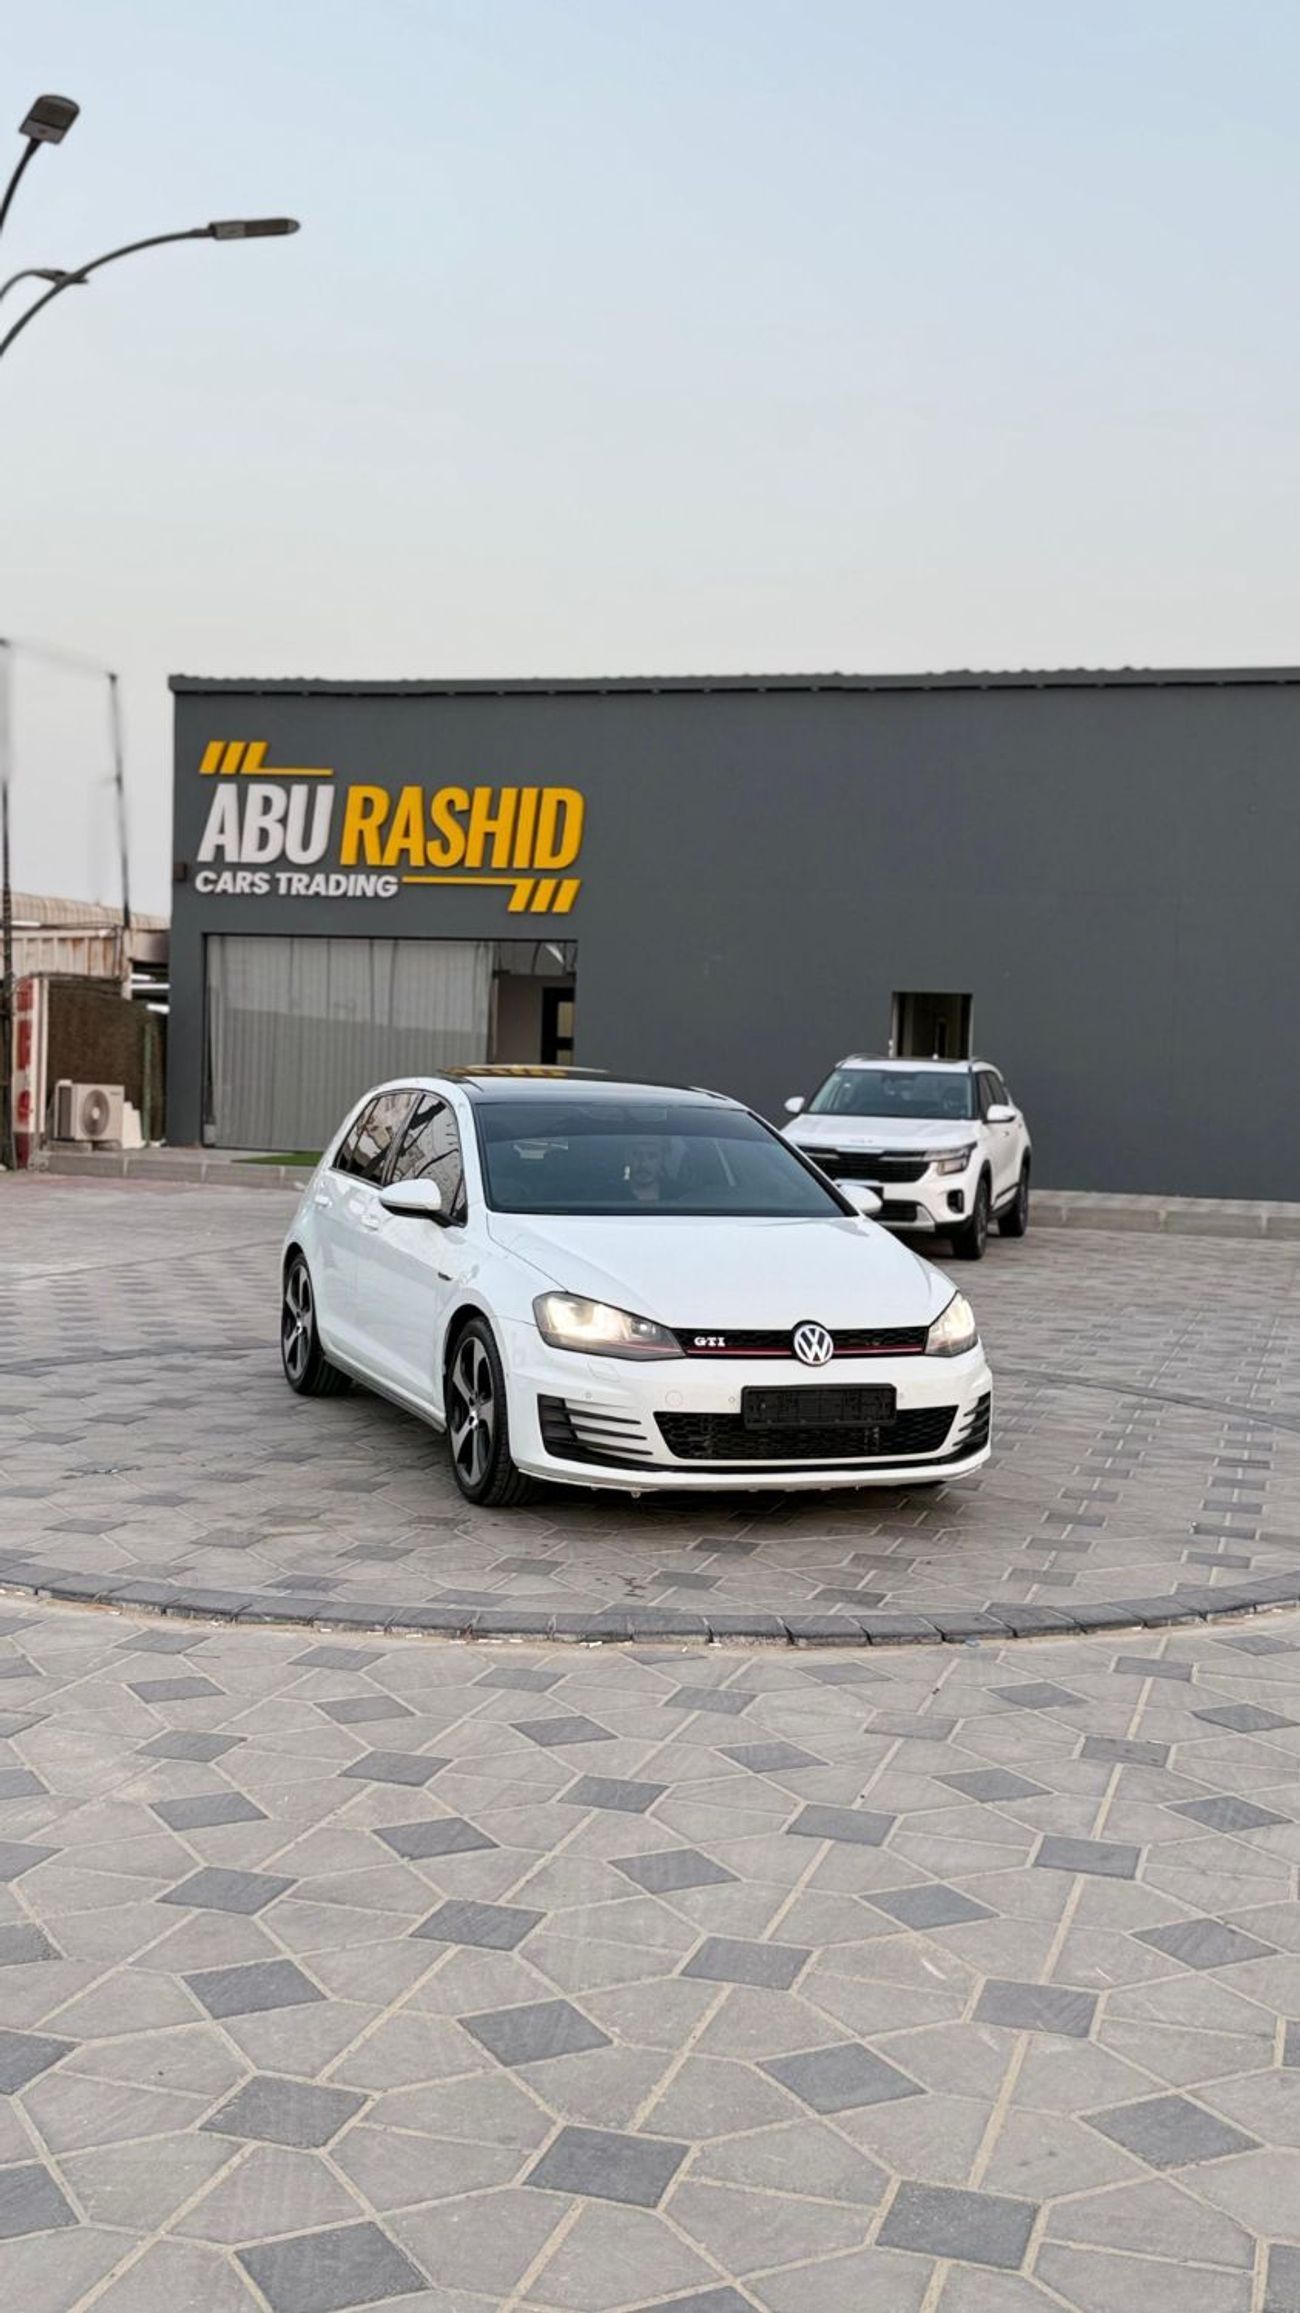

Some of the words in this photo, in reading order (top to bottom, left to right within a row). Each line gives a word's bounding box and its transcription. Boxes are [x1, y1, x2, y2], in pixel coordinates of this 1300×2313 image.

[197, 783, 335, 865] ABU
[340, 785, 585, 870] RASHID
[195, 870, 271, 895] CARS
[275, 872, 399, 898] TRADING
[693, 1336, 727, 1347] GTI
[794, 1325, 833, 1365] VW
